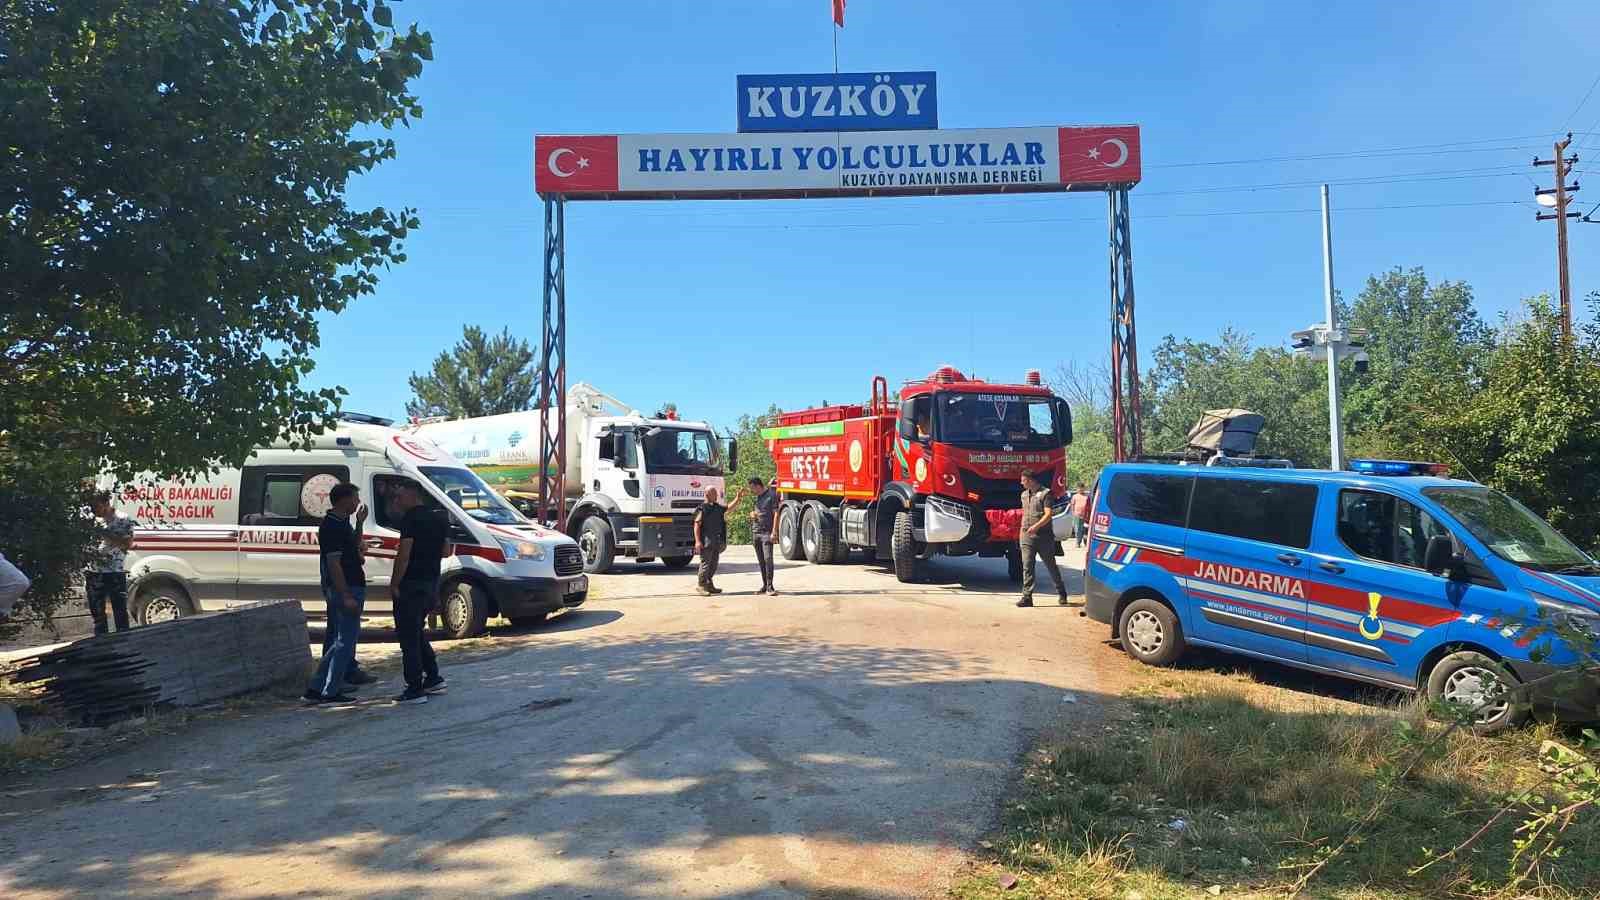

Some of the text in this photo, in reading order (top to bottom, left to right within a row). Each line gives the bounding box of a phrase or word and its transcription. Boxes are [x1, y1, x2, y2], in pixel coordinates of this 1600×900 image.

[748, 75, 927, 118] KUZKÖY
[638, 142, 1046, 172] HAYIRLI YOLCULUKLAR
[842, 167, 1043, 187] KUZKÖY DAYANIŞMA DERNEĞİ
[168, 484, 233, 501] BAKANLIĞI
[168, 502, 215, 518] SAĞLIK
[1097, 514, 1109, 525] 112
[240, 530, 320, 545] AMBULAN
[1193, 562, 1305, 599] JANDARMA
